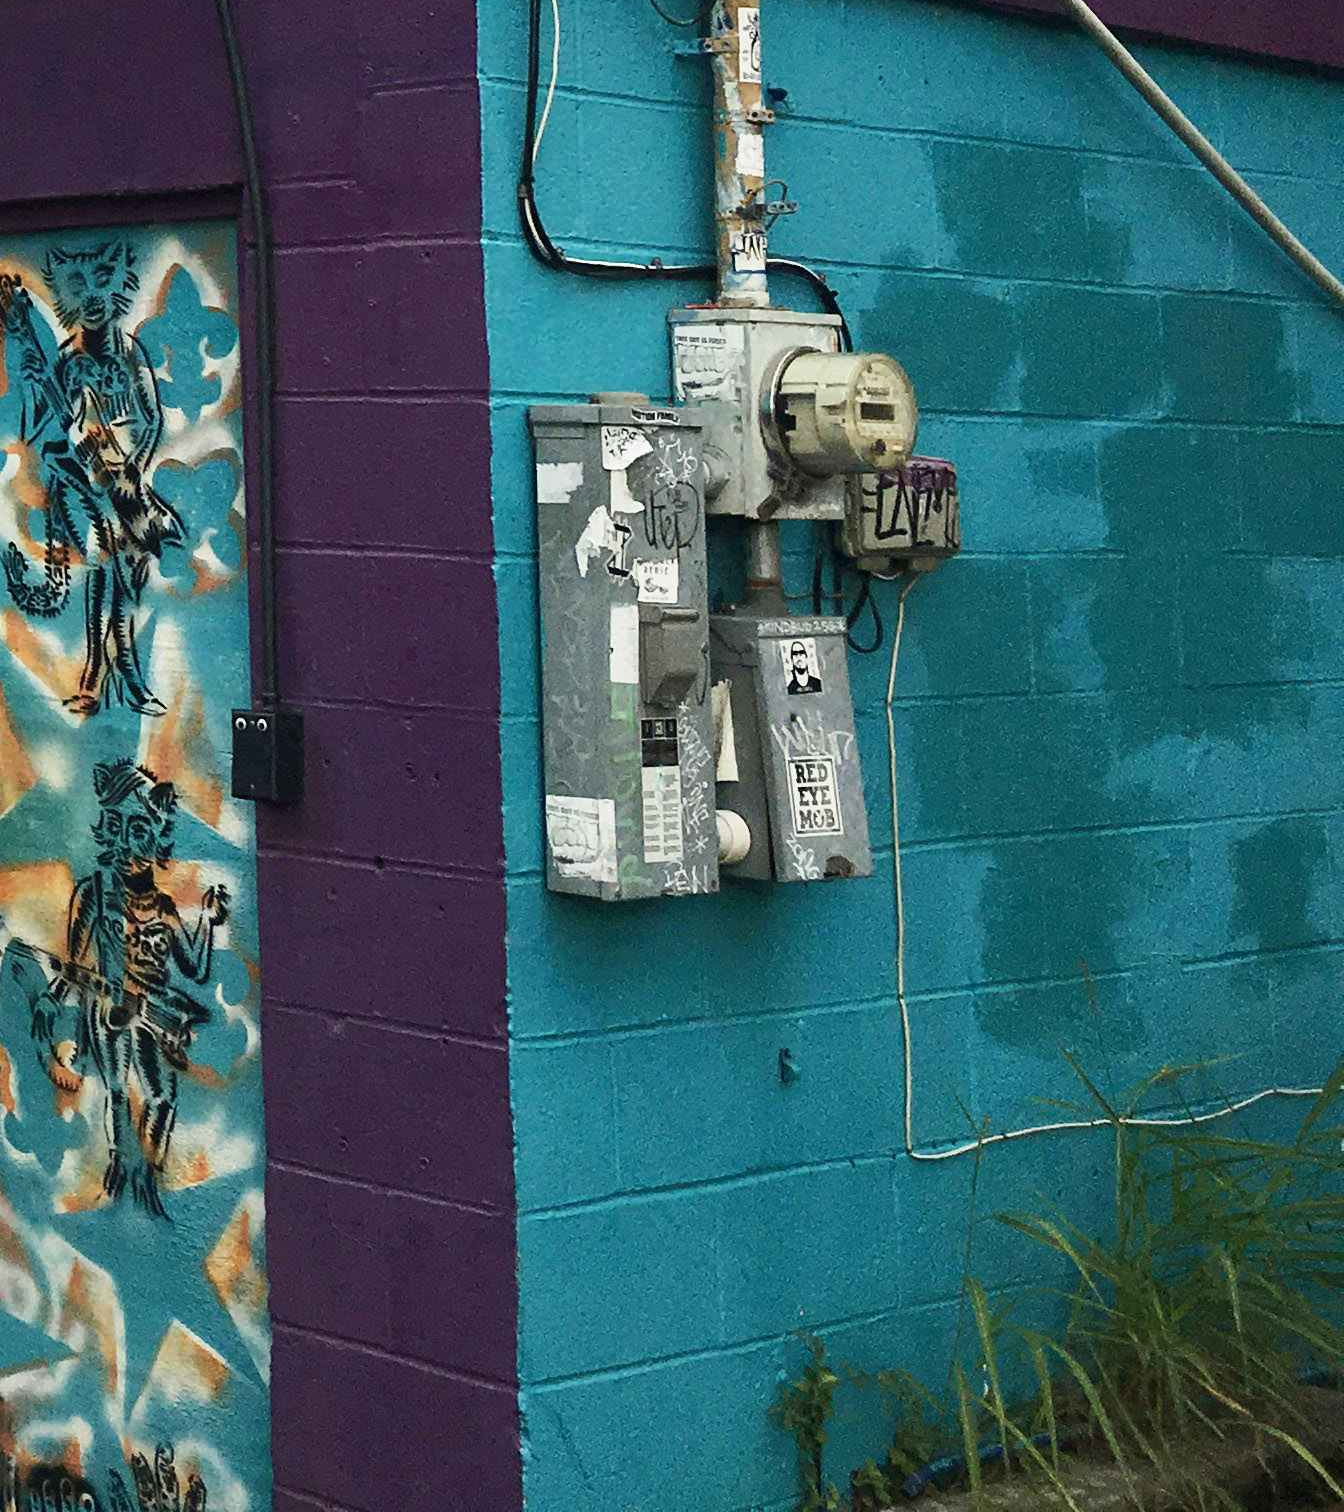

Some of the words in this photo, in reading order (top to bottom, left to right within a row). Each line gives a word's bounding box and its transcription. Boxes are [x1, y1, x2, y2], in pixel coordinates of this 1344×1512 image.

[794, 762, 828, 784] RED
[797, 785, 832, 807] EYE
[799, 808, 836, 830] MOB
